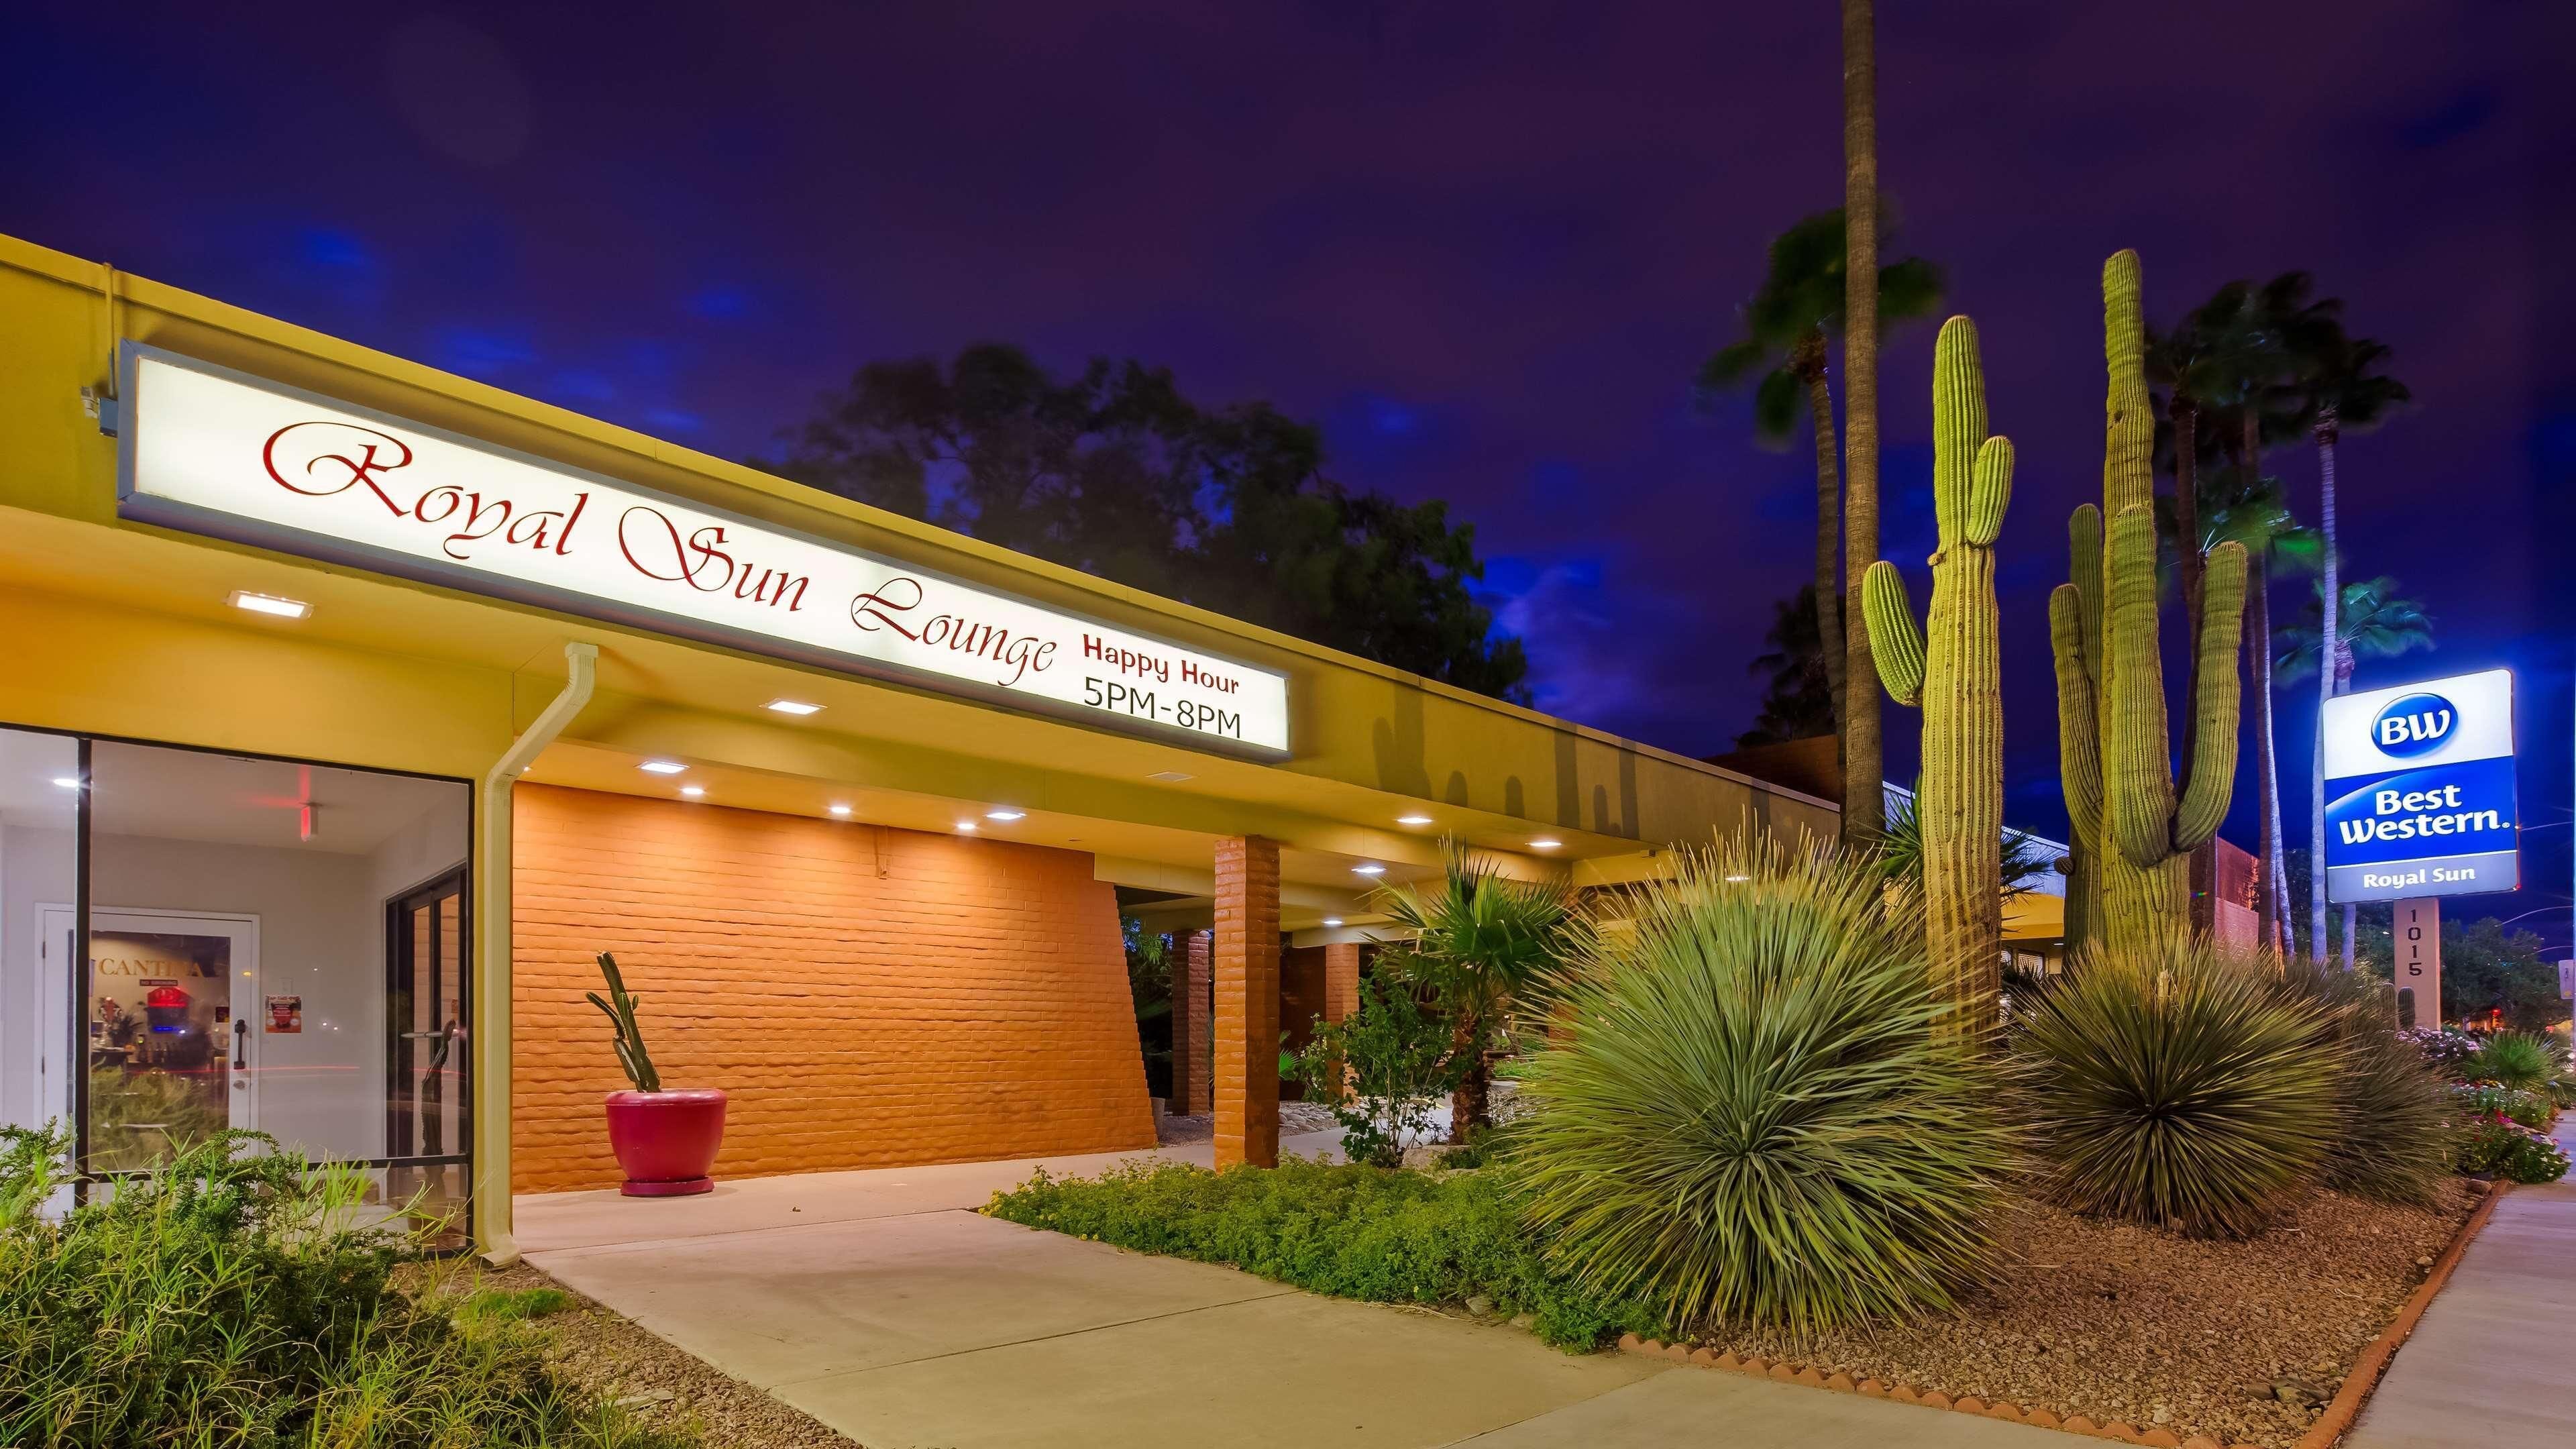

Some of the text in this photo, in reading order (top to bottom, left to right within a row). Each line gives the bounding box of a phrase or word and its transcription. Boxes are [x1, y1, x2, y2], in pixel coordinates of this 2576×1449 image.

[263, 421, 1057, 687] Royal Sun Lounge
[1083, 633, 1240, 694] Happy Hour
[1083, 676, 1241, 739] 5PM-8PM
[2380, 708, 2451, 745] BW
[2375, 784, 2463, 816] Best
[2363, 867, 2476, 889] Royal Sun
[2408, 909, 2422, 977] 1015
